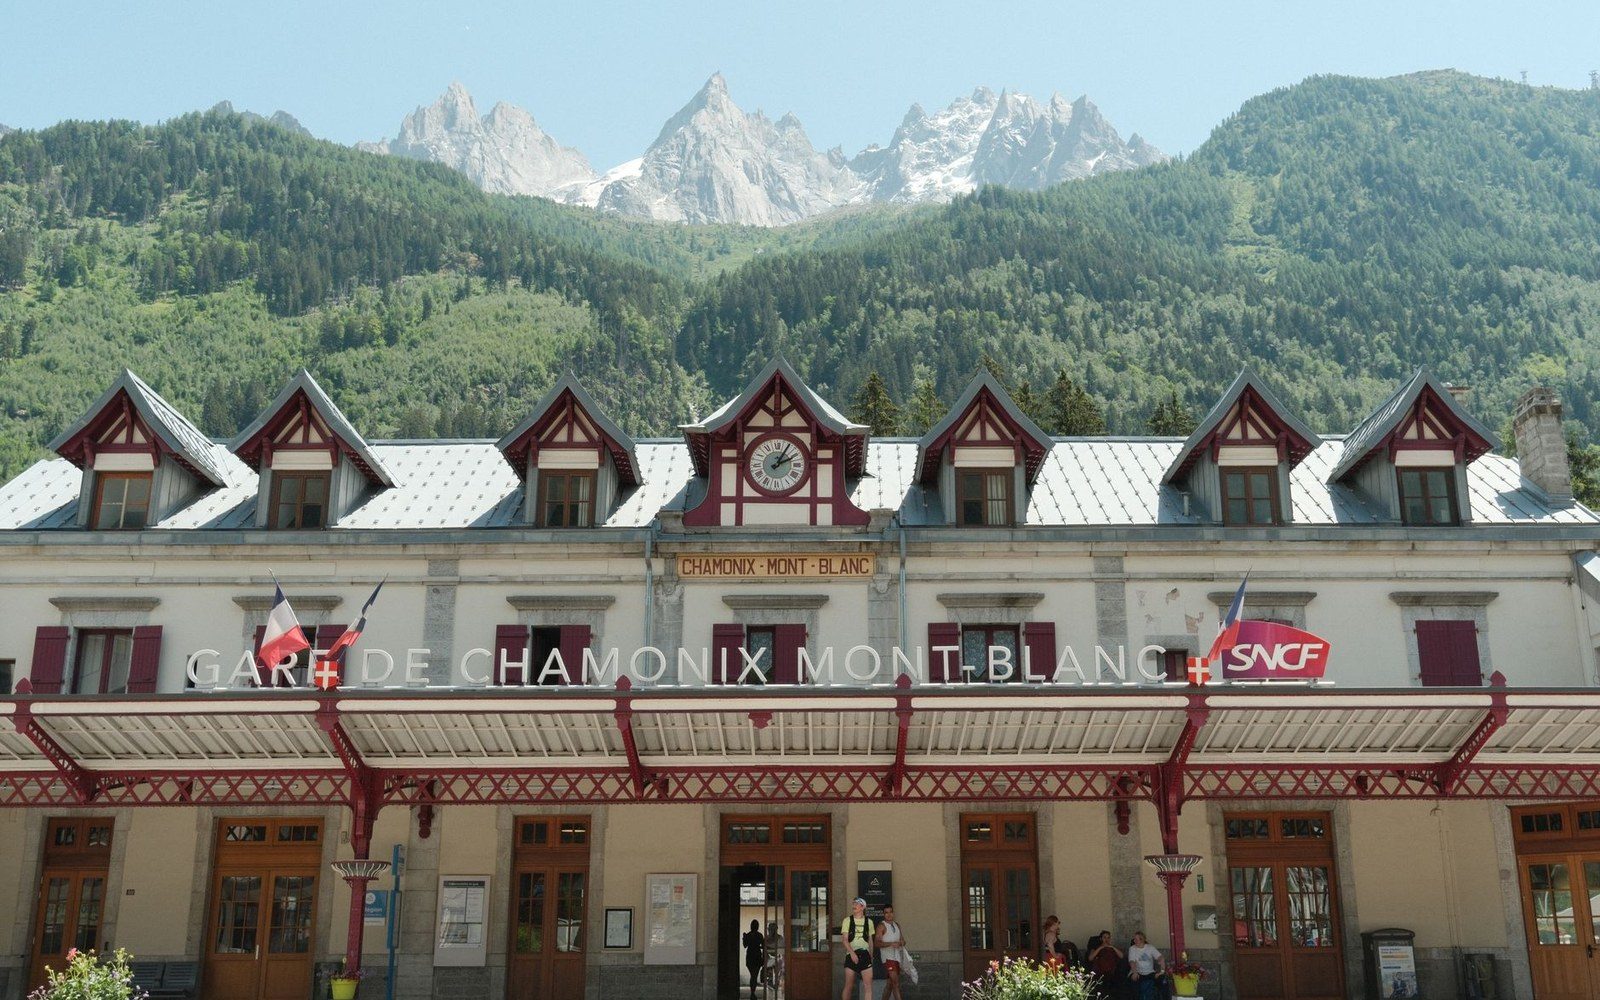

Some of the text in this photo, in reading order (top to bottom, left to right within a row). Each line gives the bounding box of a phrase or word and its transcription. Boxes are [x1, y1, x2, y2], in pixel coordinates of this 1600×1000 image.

[682, 558, 756, 575] CHAMONIX
[767, 558, 808, 575] MONT
[818, 557, 870, 575] BLANC
[363, 648, 431, 685] DE
[460, 646, 767, 683] CHAMONIX
[797, 644, 1168, 682] MONT-BLANC
[1227, 643, 1324, 672] SNCF
